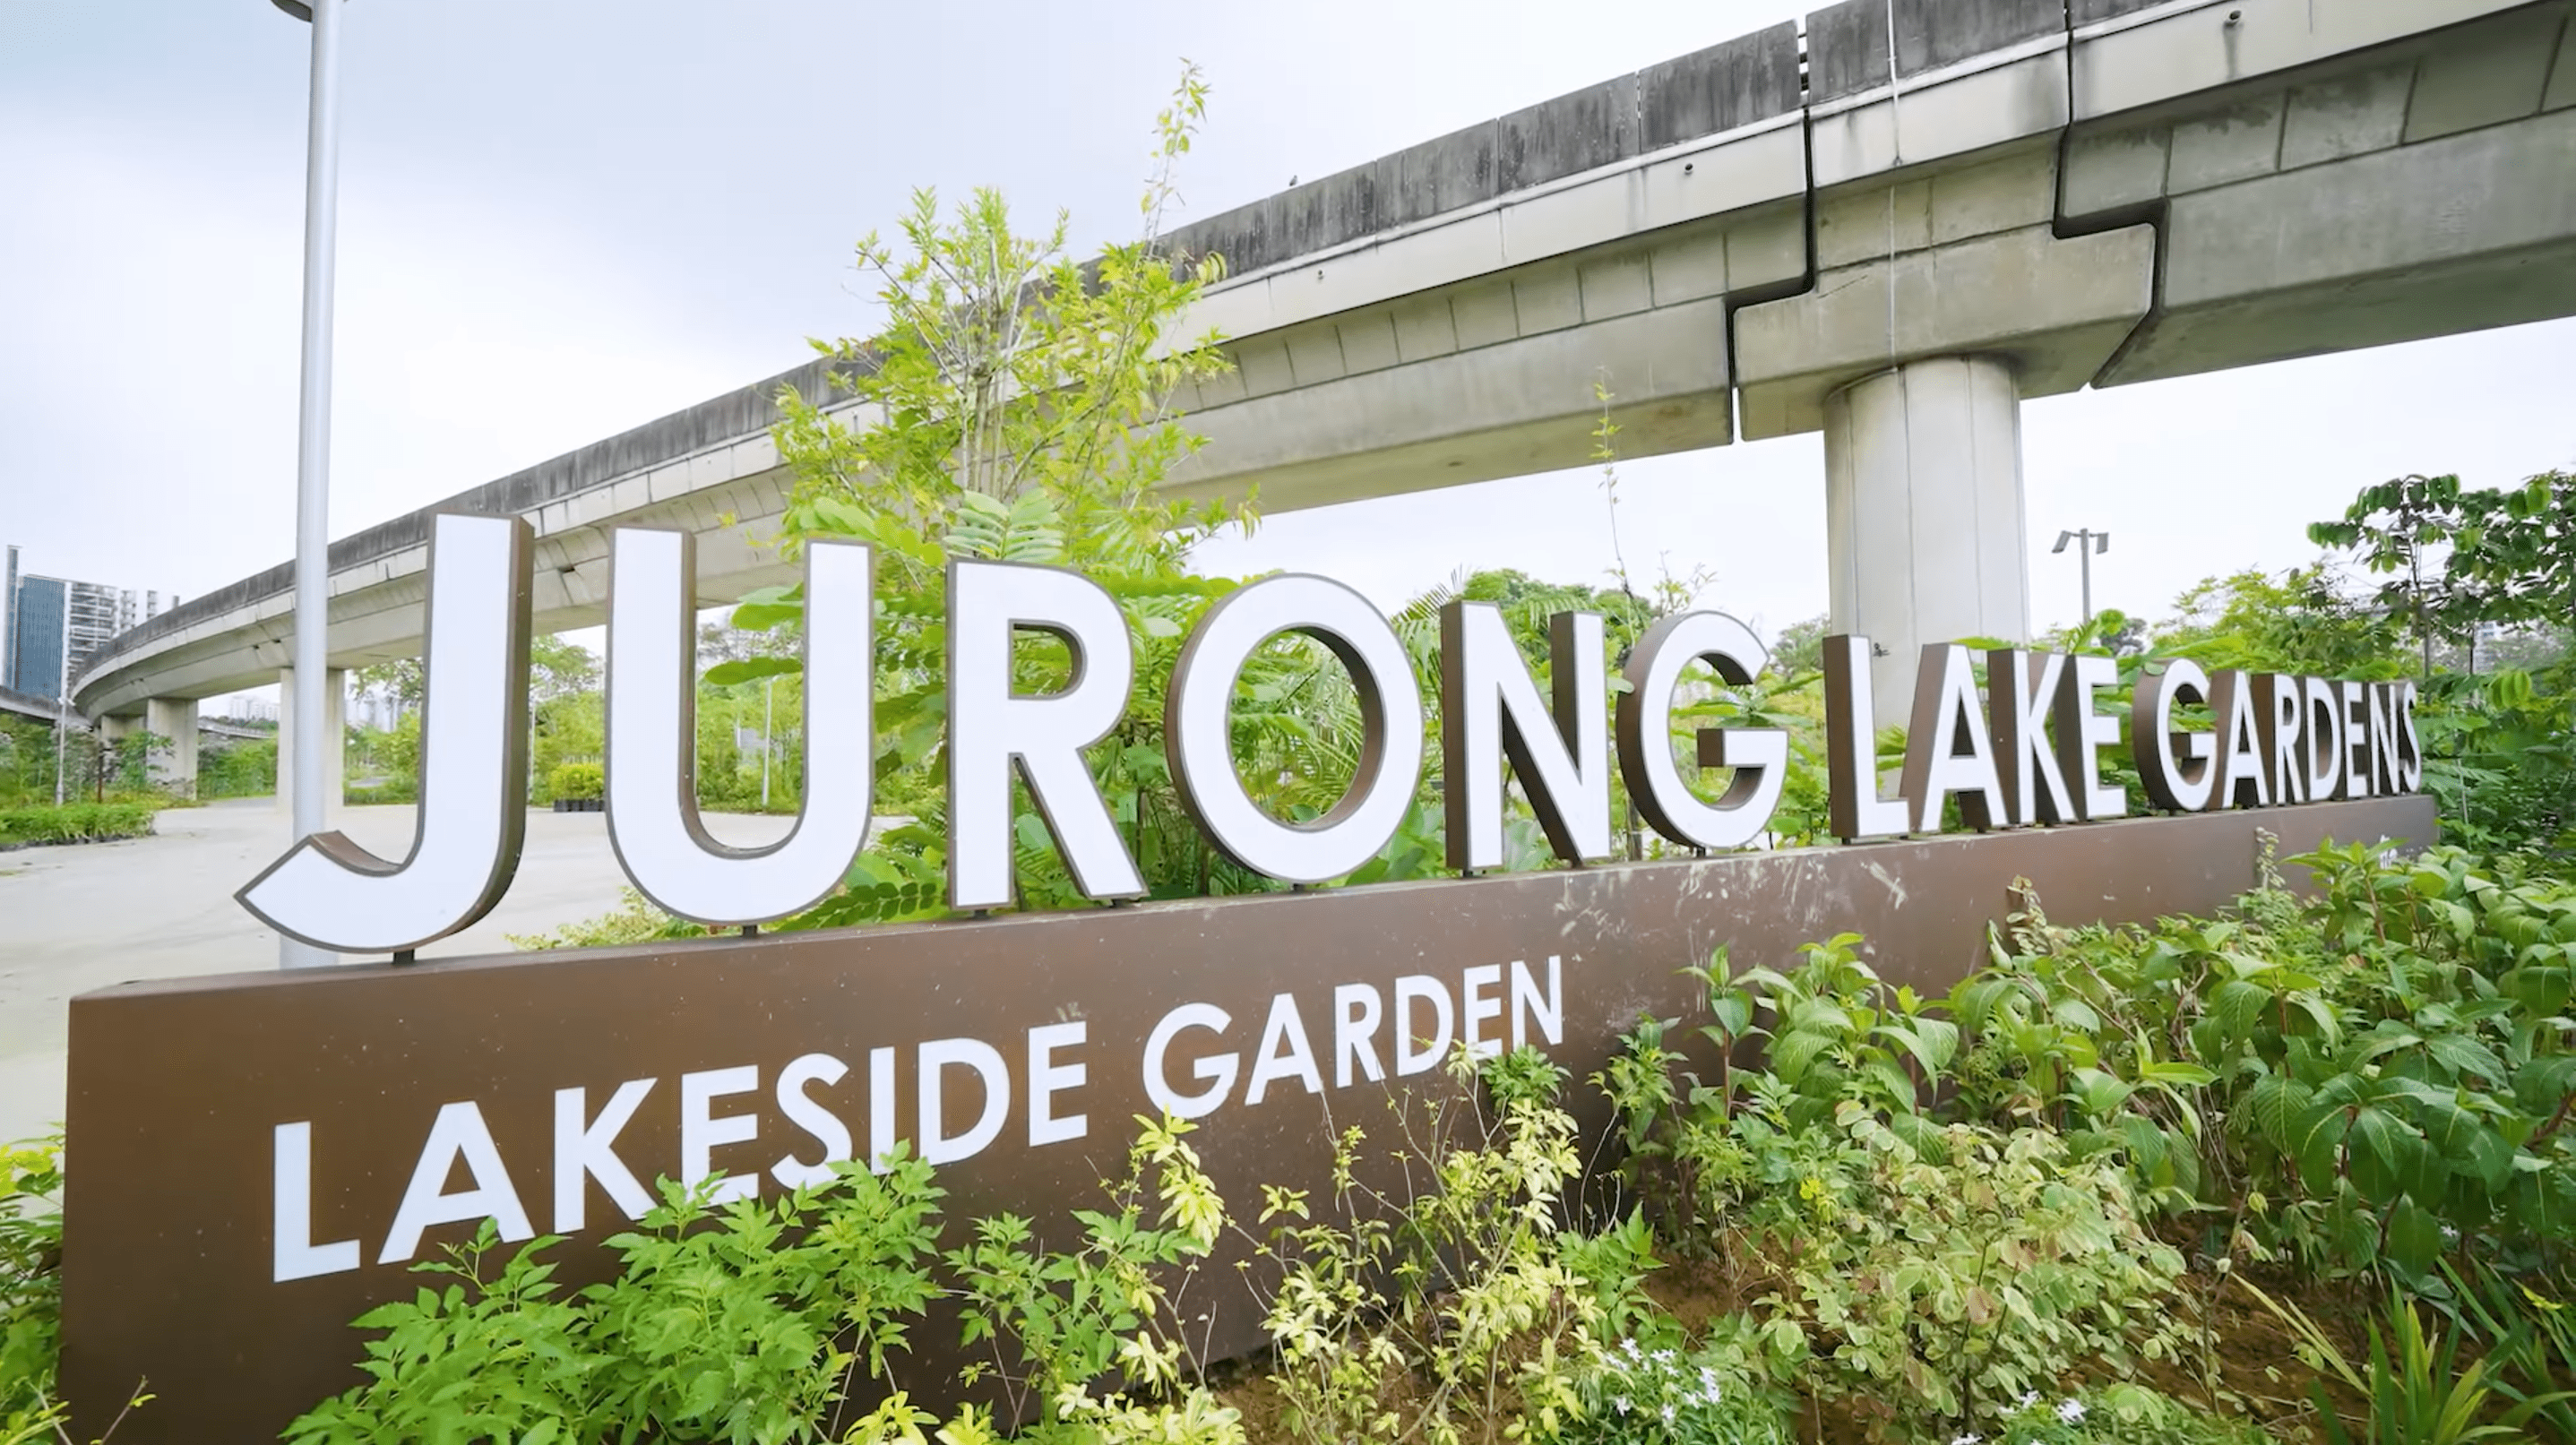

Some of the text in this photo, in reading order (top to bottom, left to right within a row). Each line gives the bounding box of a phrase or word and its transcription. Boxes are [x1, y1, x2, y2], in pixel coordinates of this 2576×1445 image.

[235, 513, 2422, 952] JURONG LAKE GARDENS
[273, 955, 1563, 1283] LAKESIDE GARDEN
